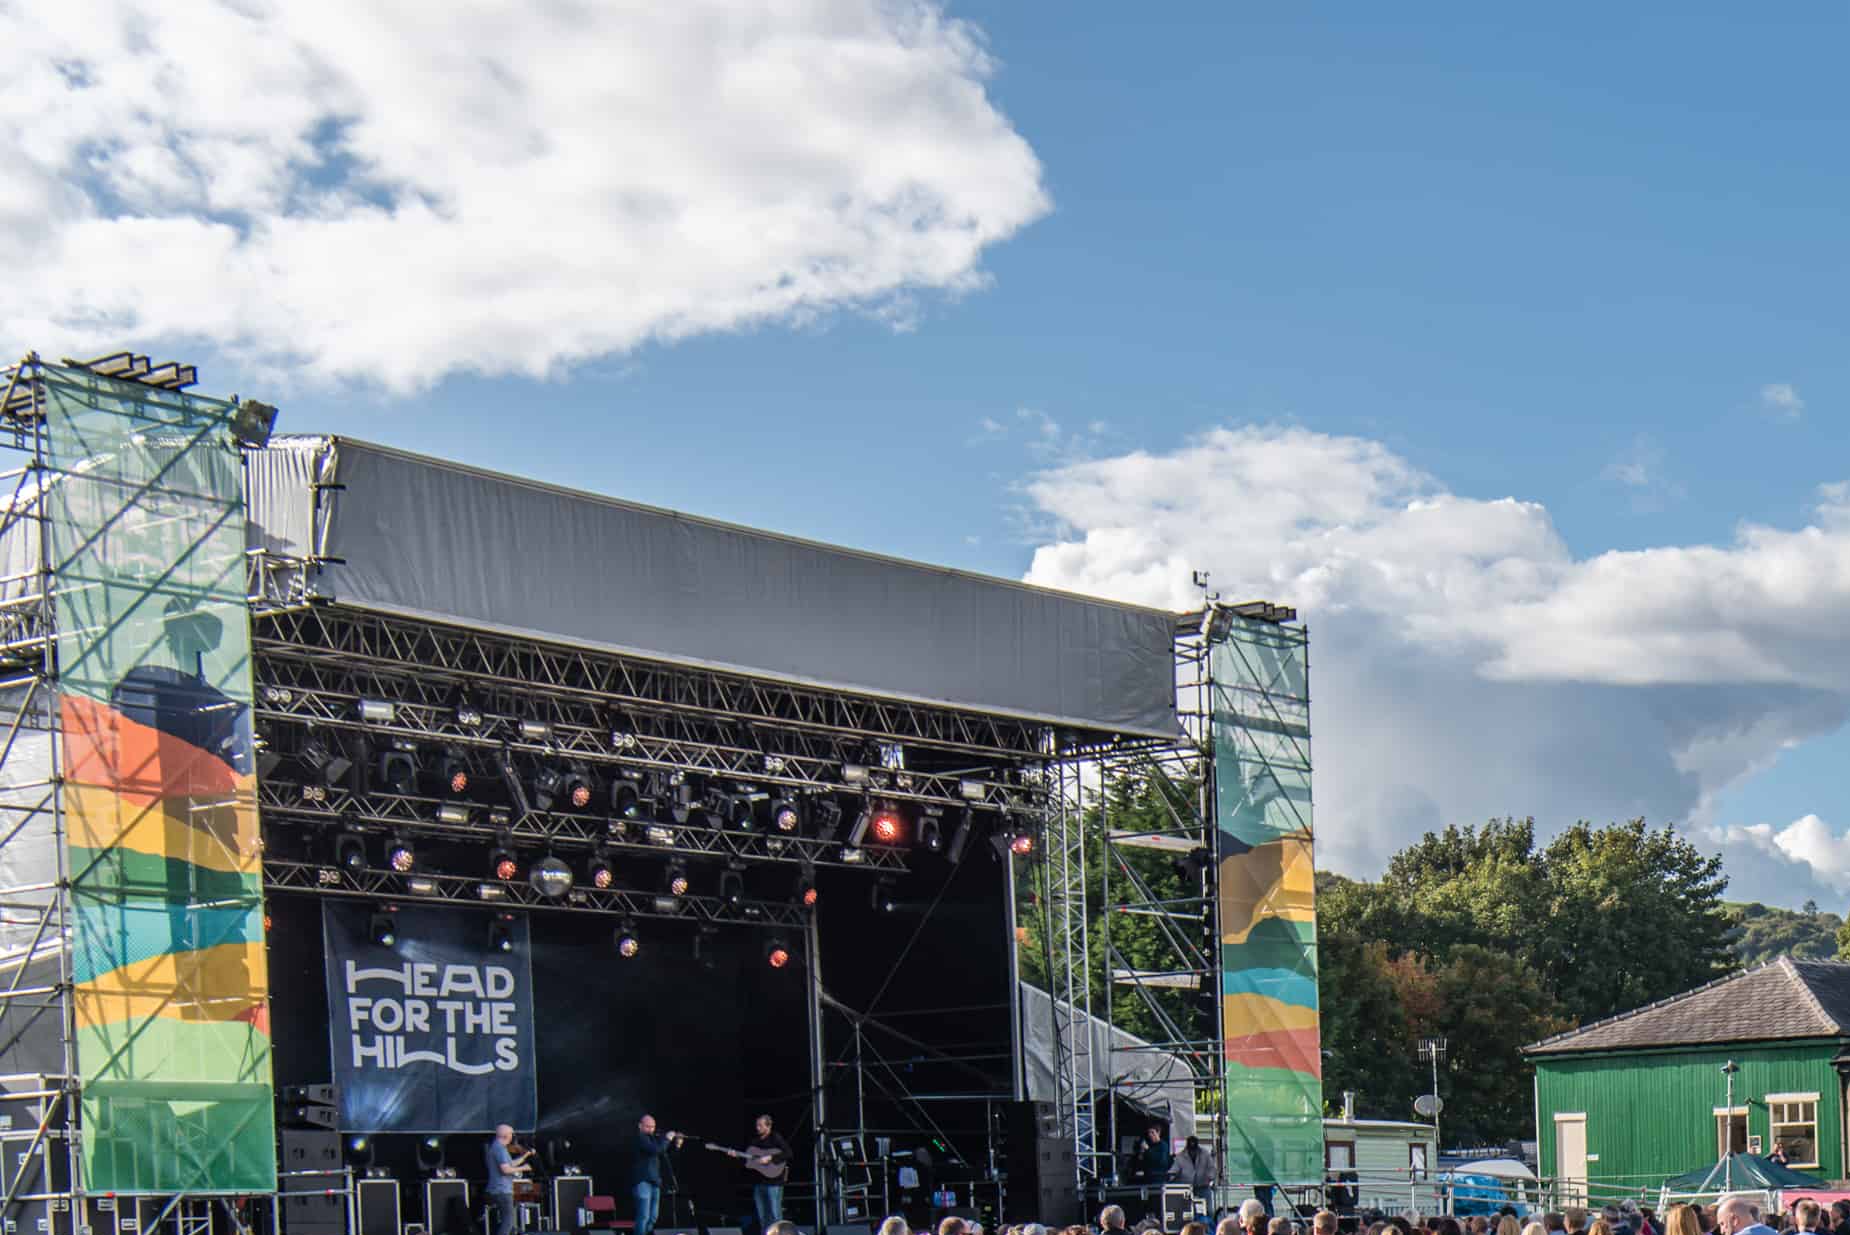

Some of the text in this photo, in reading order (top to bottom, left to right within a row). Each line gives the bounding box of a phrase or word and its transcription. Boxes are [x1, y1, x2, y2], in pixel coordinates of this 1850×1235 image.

[346, 960, 514, 999] HEAD
[348, 997, 517, 1034] FOR THE
[351, 1034, 518, 1074] HILLS
